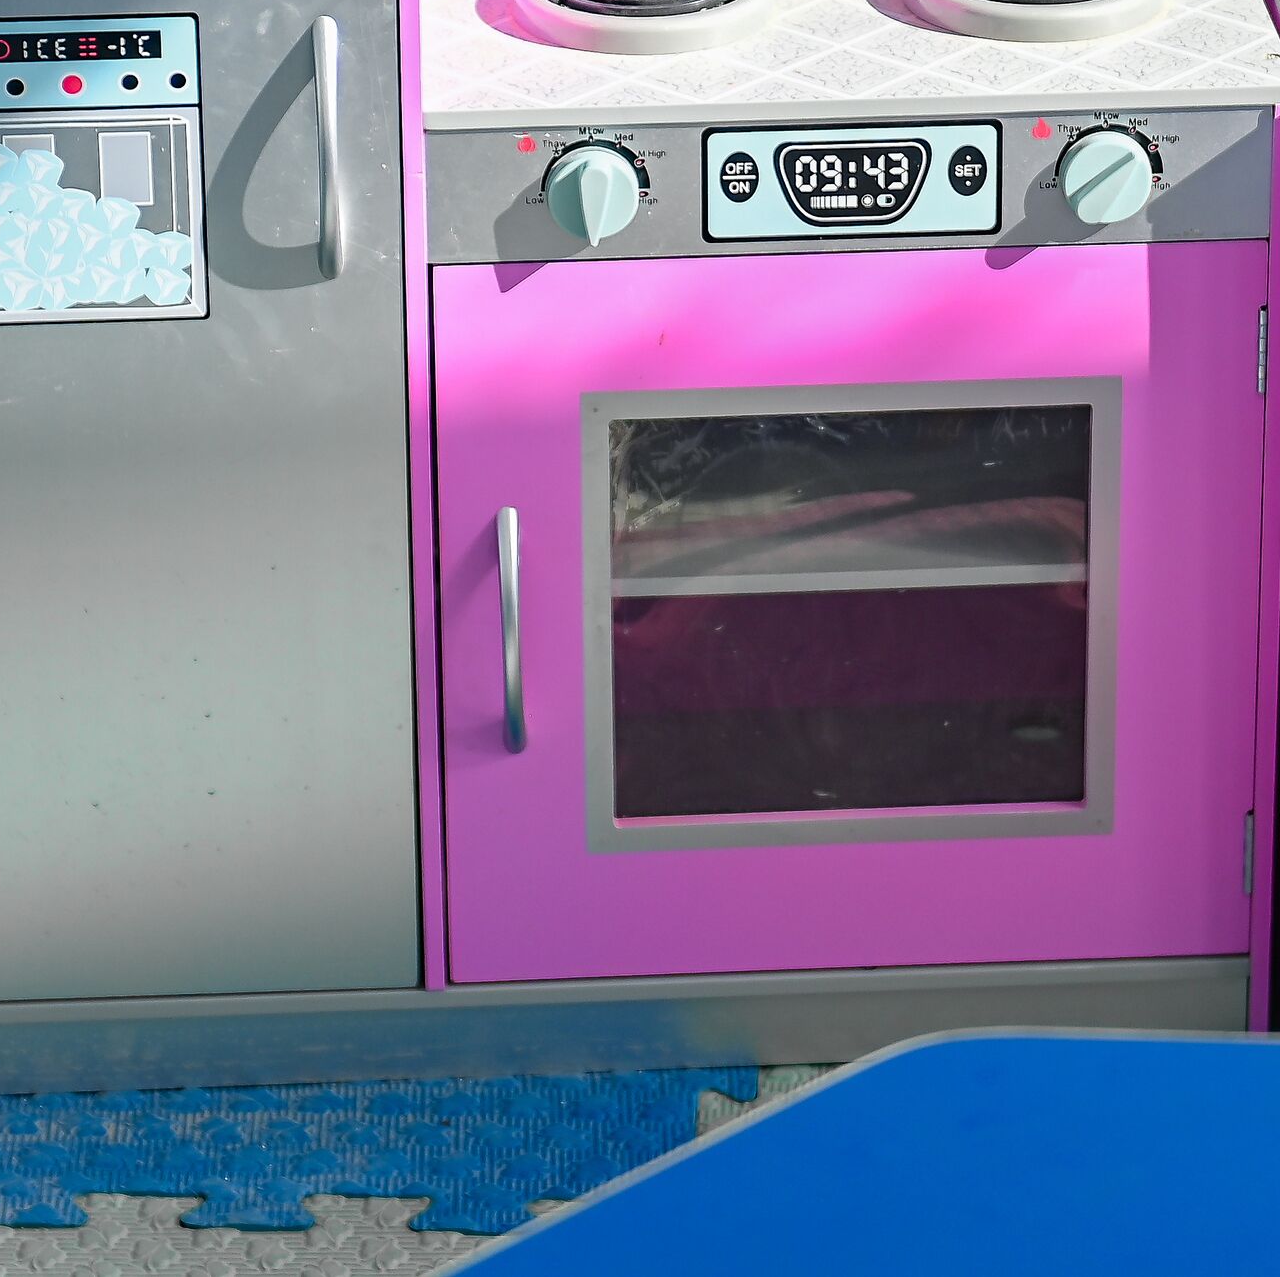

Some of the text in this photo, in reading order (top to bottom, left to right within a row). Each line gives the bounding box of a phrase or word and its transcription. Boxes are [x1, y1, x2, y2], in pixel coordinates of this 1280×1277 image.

[1129, 118, 1148, 126] Med
[1057, 124, 1082, 133] Thaw
[614, 133, 634, 141] Med
[1161, 134, 1180, 143] High
[542, 139, 567, 148] Thaw
[638, 150, 666, 159] M High
[725, 161, 754, 175] OFF
[794, 152, 910, 193] 09:43
[954, 163, 982, 178] SET
[728, 181, 751, 194] ON
[1039, 180, 1058, 189] Low
[1152, 182, 1170, 191] High
[525, 196, 545, 204] Low
[639, 197, 658, 206] High
